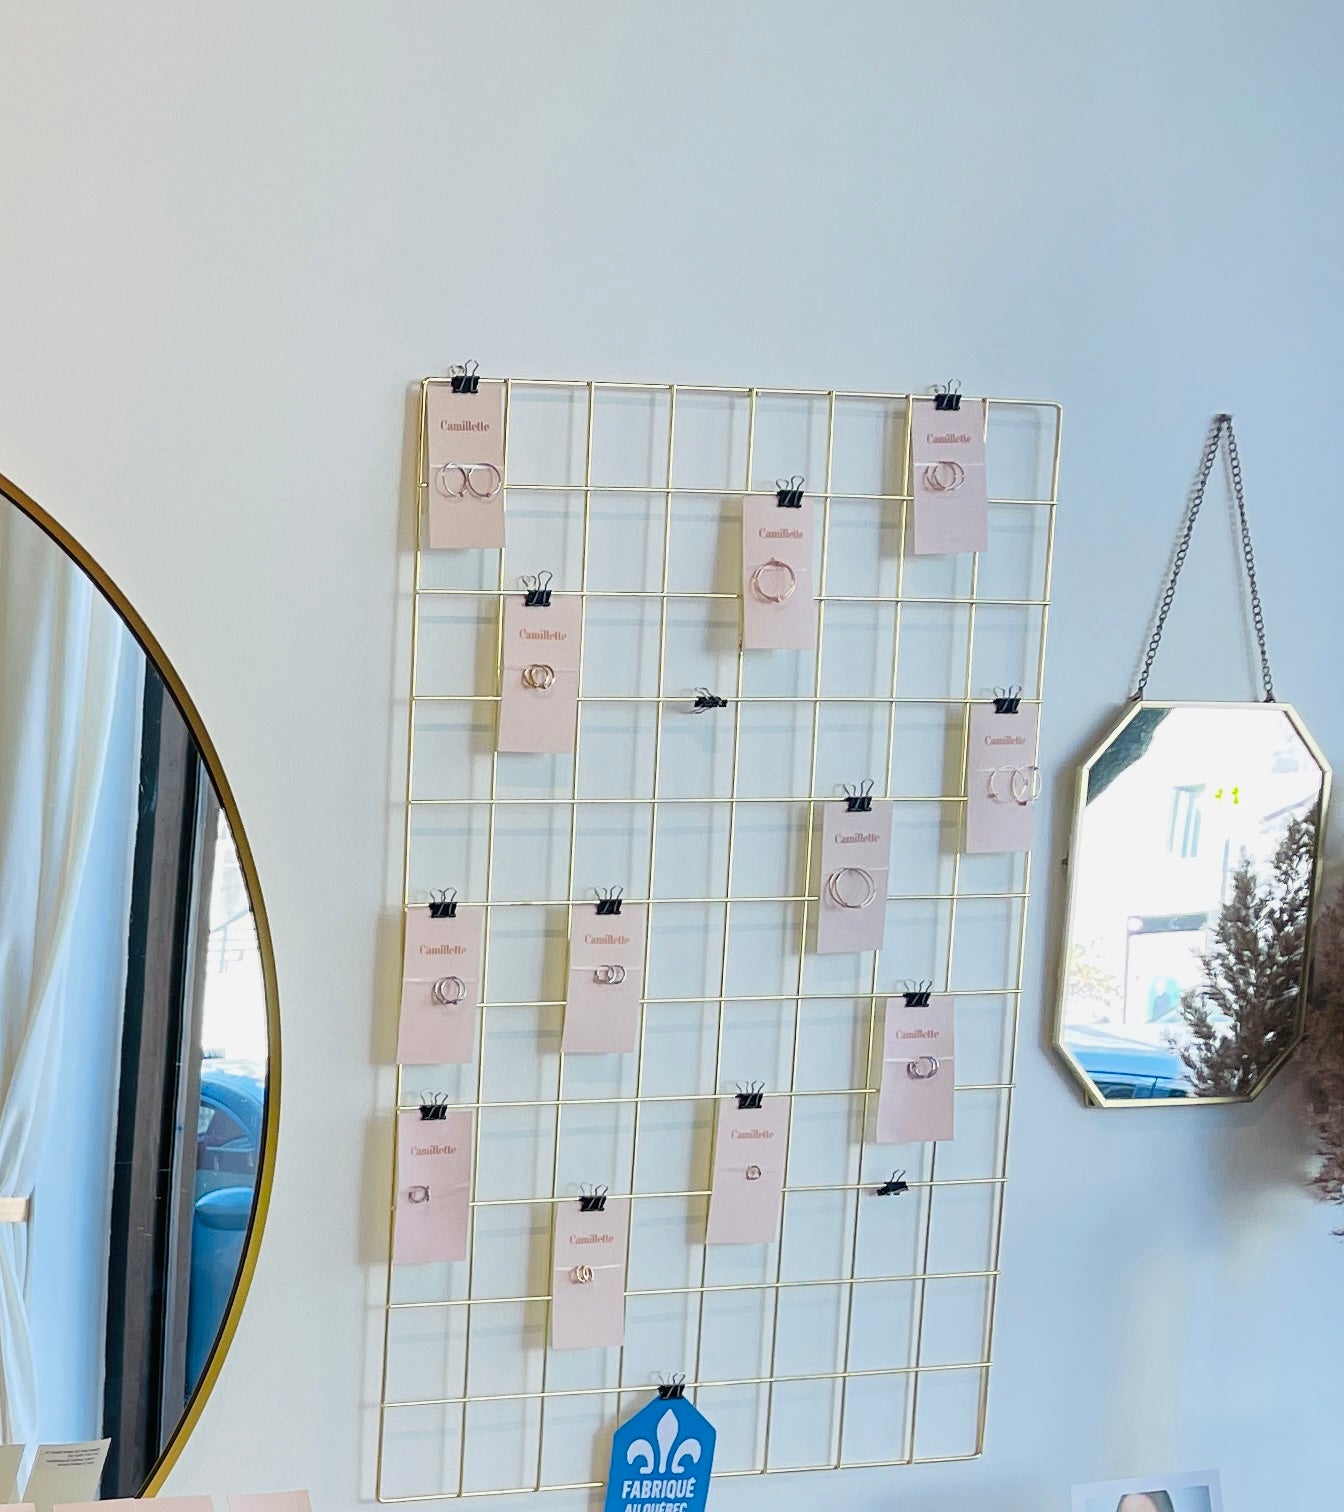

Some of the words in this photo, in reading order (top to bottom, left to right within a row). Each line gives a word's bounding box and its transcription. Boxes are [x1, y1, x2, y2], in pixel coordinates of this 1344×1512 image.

[440, 420, 490, 432] Camillette
[926, 433, 972, 444] Camillette
[758, 528, 804, 540] Camillette
[519, 628, 567, 641] Camillette
[984, 735, 1026, 745] Camillette
[834, 832, 880, 844] Camillette
[584, 934, 630, 945] Camillette
[419, 945, 467, 955] Camillette
[895, 1029, 940, 1040] Camillette
[730, 1128, 774, 1140] Camillette
[410, 1145, 457, 1156] Camillette
[569, 1234, 614, 1245] Camillette
[622, 1477, 696, 1499] FABRIQUÉ
